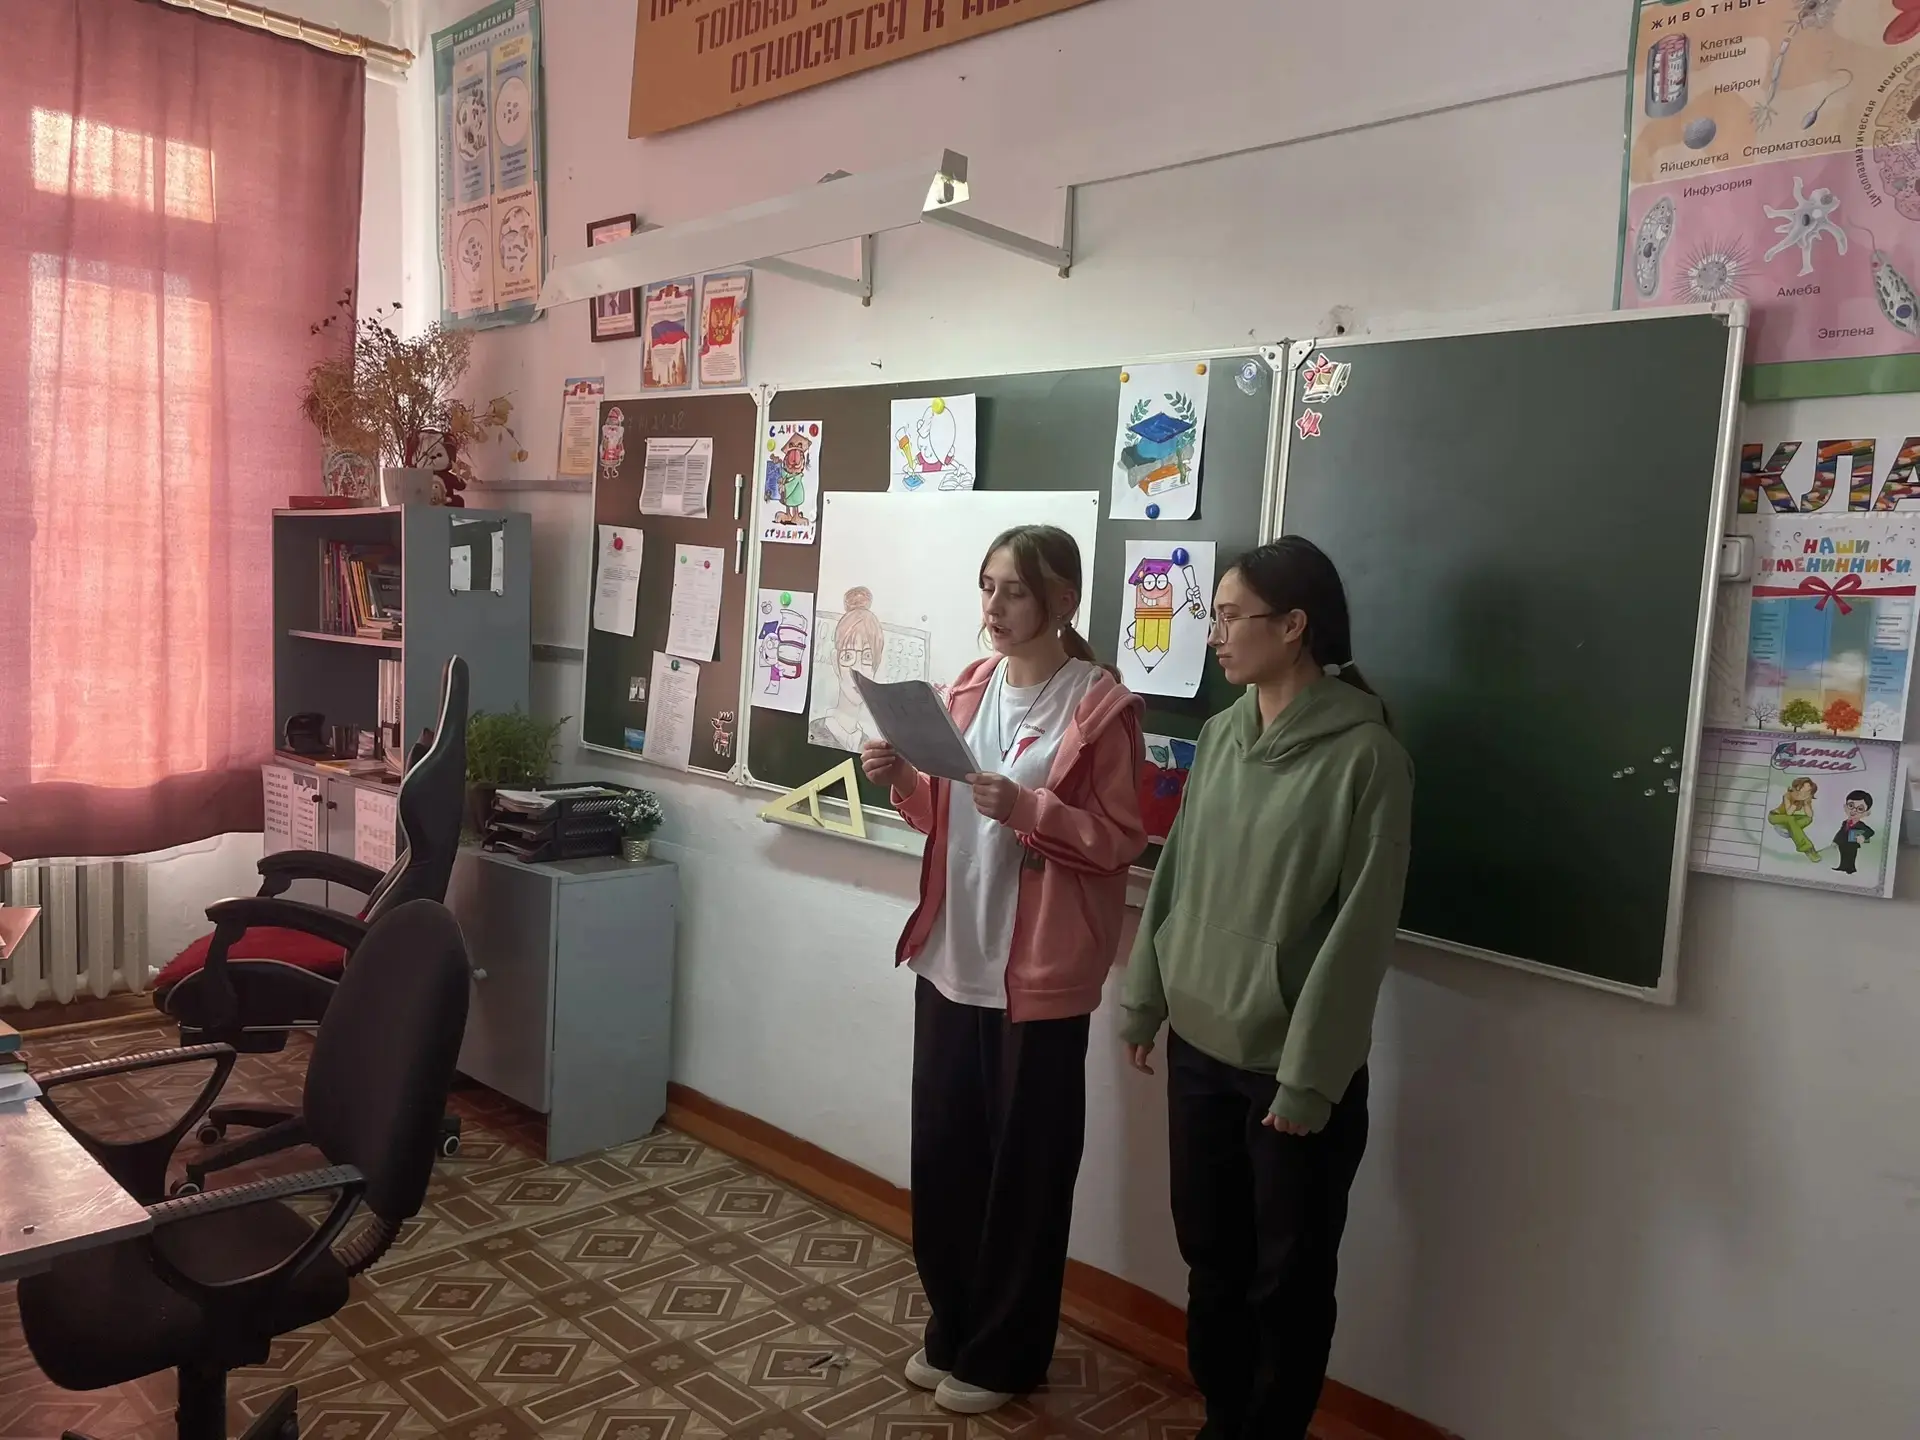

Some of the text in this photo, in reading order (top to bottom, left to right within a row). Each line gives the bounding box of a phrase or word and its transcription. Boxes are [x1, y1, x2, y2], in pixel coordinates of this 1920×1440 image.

[730, 0, 908, 94] ОТНОСЯТСЯ
[1700, 35, 1743, 51] Клетка
[1700, 47, 1747, 63] мышцы
[1714, 77, 1761, 95] Нейрон
[1743, 133, 1842, 158] Сперматозоид
[1660, 152, 1730, 174] Яйцеклетка
[1855, 100, 1884, 209] Цитоплазматическая
[1683, 177, 1753, 199] Инфузория
[1777, 284, 1821, 298] Амеба
[1818, 326, 1875, 340] Эвглена
[769, 425, 776, 437] С
[764, 526, 814, 541] СТУДЕНТА!
[1803, 537, 1870, 556] НАШИ
[1761, 557, 1912, 574] ИМЕНИННИКИ
[1784, 742, 1860, 759] Актив
